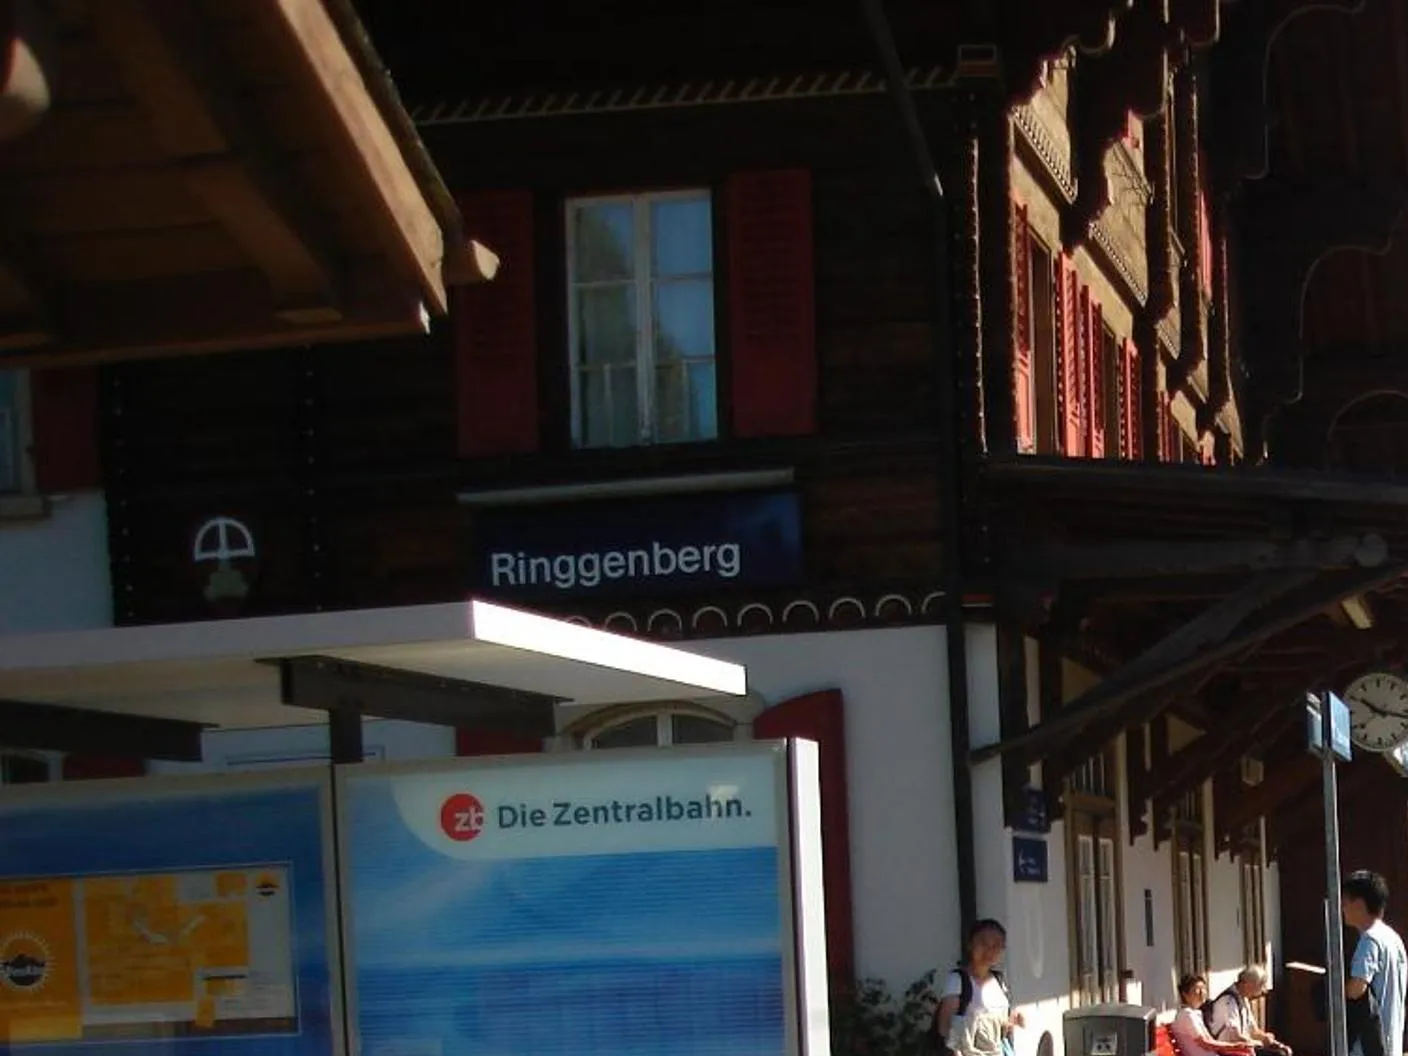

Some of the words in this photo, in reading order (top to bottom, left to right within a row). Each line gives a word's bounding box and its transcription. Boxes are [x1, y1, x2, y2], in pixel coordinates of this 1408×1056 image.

[491, 541, 741, 588] Ringgenberg
[498, 804, 546, 829] Die
[553, 796, 752, 827] Zentralbahn.
